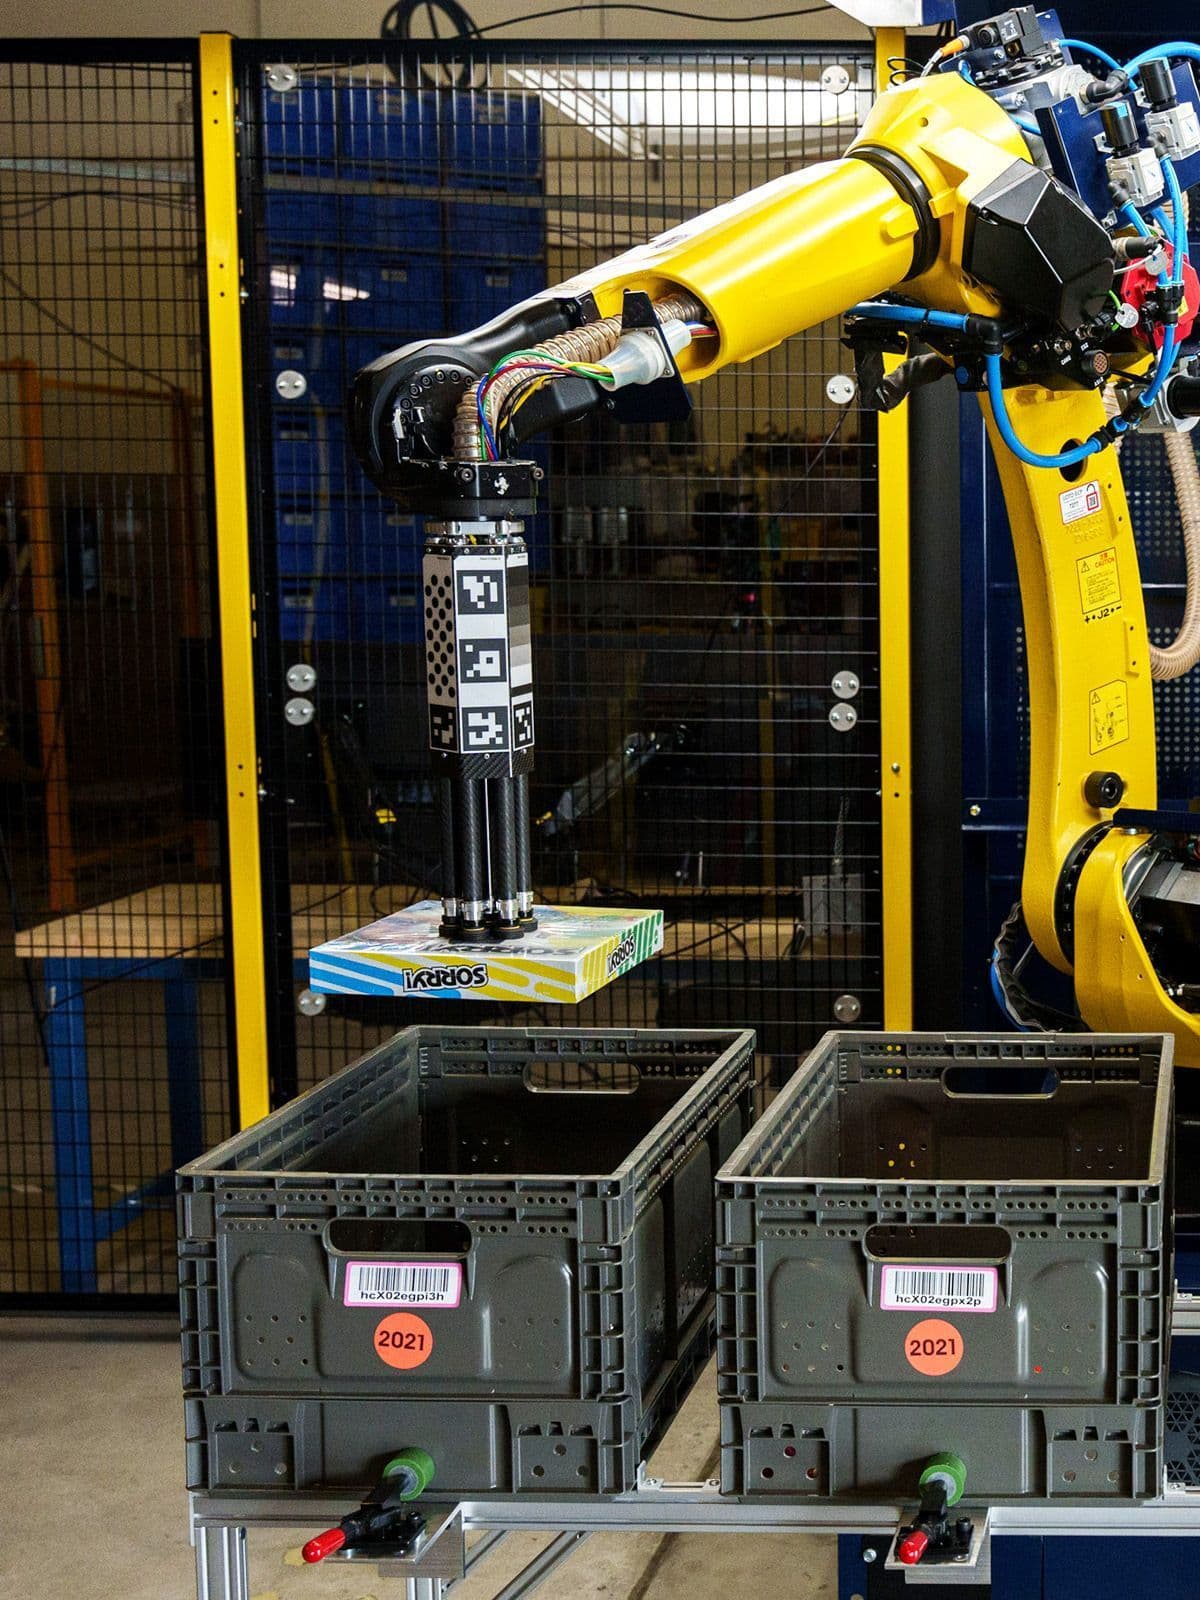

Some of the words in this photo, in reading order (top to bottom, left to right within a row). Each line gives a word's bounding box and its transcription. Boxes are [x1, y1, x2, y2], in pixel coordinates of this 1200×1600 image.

[404, 965, 487, 990] SORRY!
[360, 1291, 444, 1302] hcX02egpi3h
[896, 1295, 982, 1307] hcX02egpx2p
[378, 1330, 425, 1351] 2021
[910, 1338, 956, 1356] 2021
